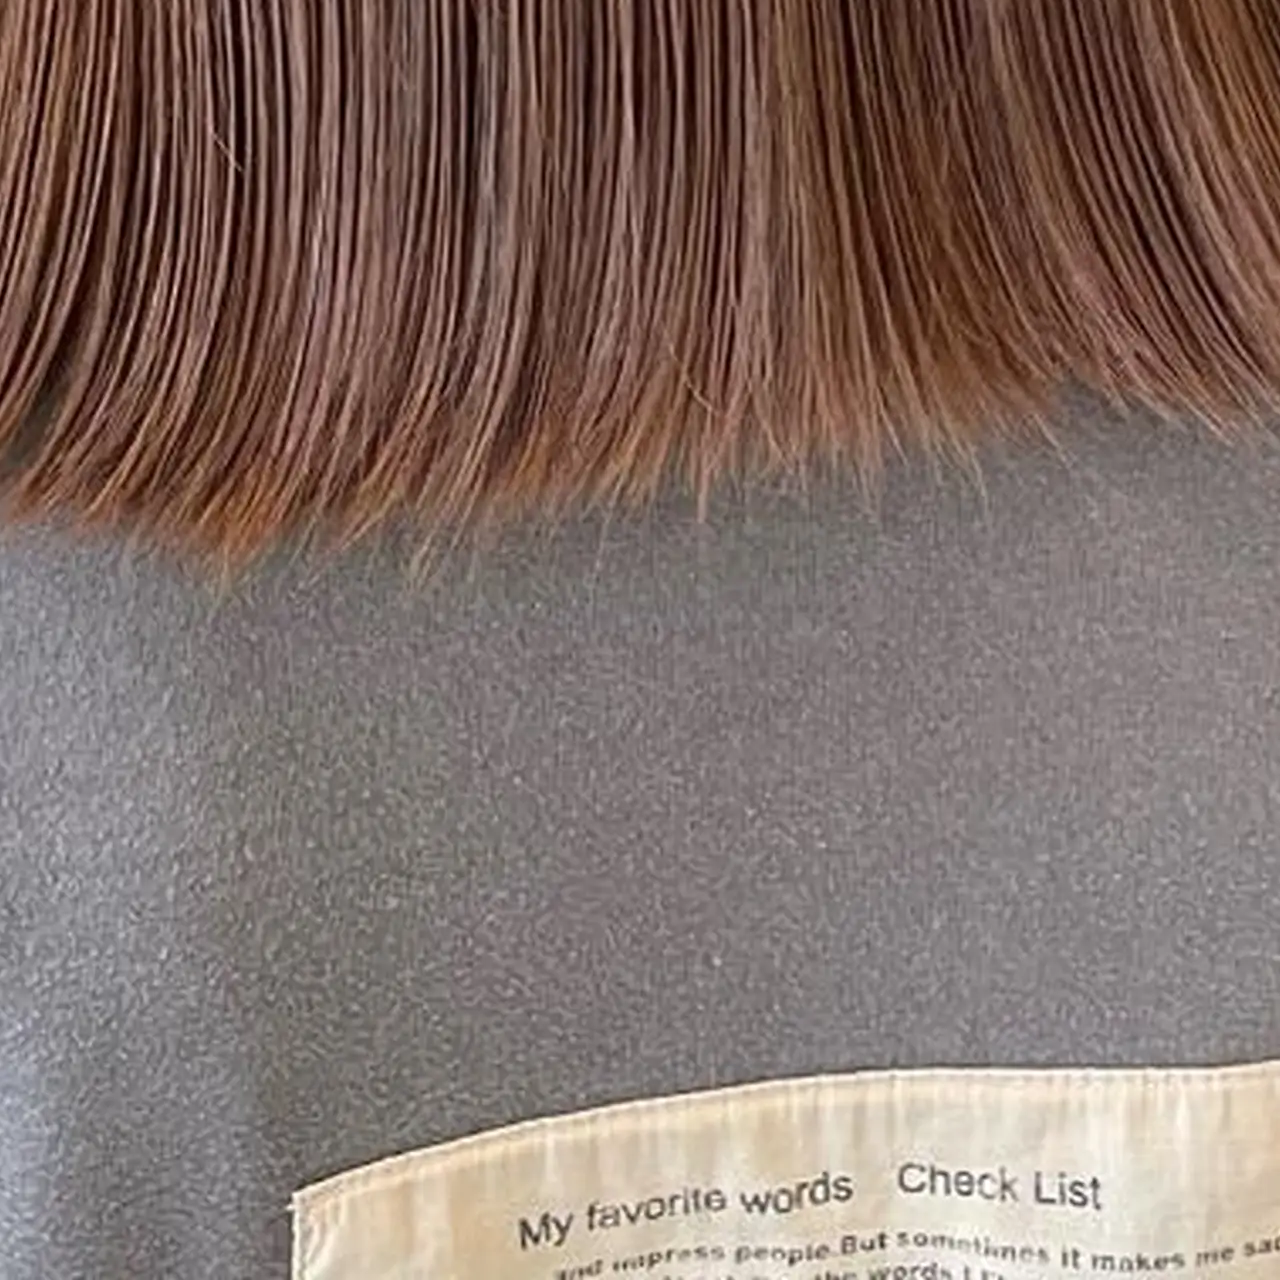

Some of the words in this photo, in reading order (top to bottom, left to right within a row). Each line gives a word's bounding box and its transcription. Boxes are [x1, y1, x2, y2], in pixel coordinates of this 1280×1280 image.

[517, 1211, 573, 1250] My
[587, 1188, 727, 1231] favorite
[740, 1171, 854, 1215] words
[897, 1162, 1020, 1202] Check
[1034, 1170, 1102, 1210] List
[1061, 1248, 1081, 1270] it
[1091, 1251, 1186, 1272] makes
[1195, 1247, 1235, 1268] me
